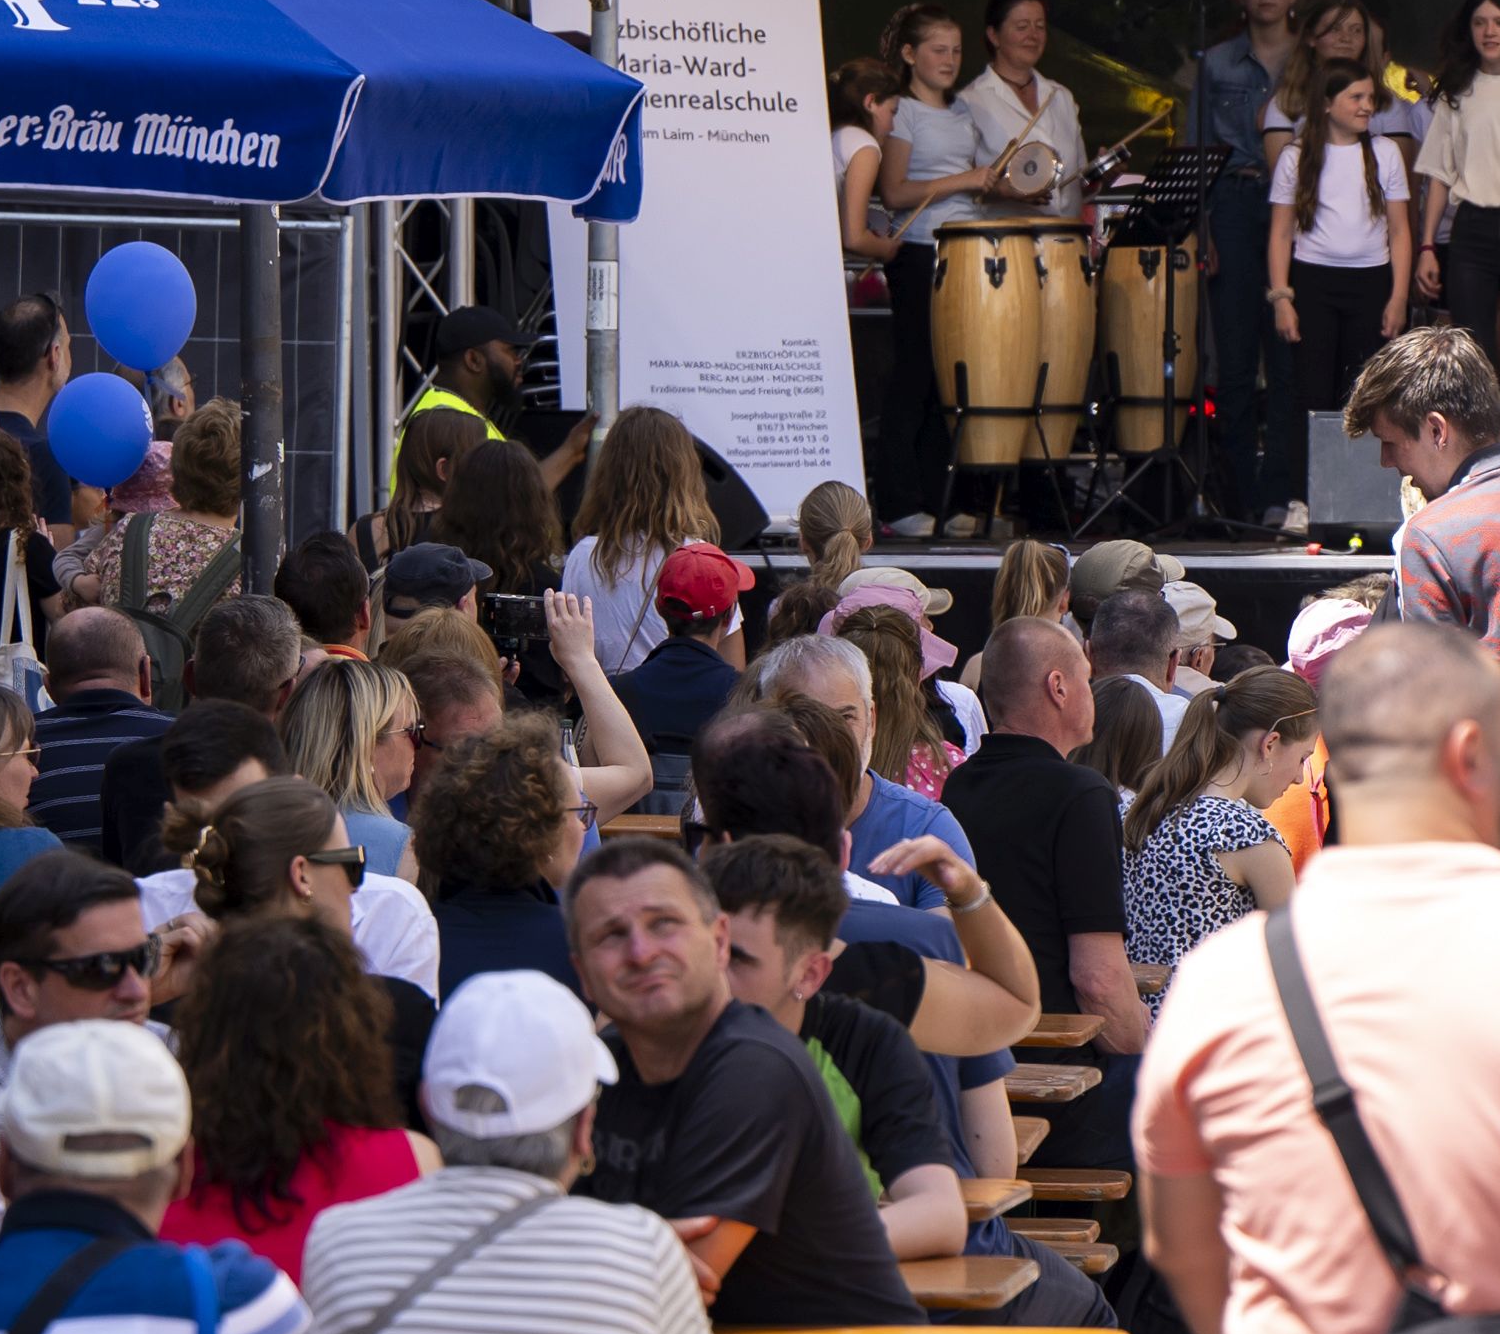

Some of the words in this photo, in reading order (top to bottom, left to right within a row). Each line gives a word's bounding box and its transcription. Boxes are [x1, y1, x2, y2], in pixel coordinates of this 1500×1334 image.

[132, 112, 281, 168] München
[663, 129, 694, 141] Laim
[707, 130, 770, 144] München
[725, 375, 739, 383] AM
[773, 374, 823, 383] MÜNCHEN
[698, 385, 738, 395] München
[739, 387, 756, 396] und
[759, 387, 792, 397] Freising
[731, 410, 813, 422] Josephsburgstraße
[815, 410, 827, 419] 22
[787, 423, 828, 432] München
[757, 435, 776, 444] 089
